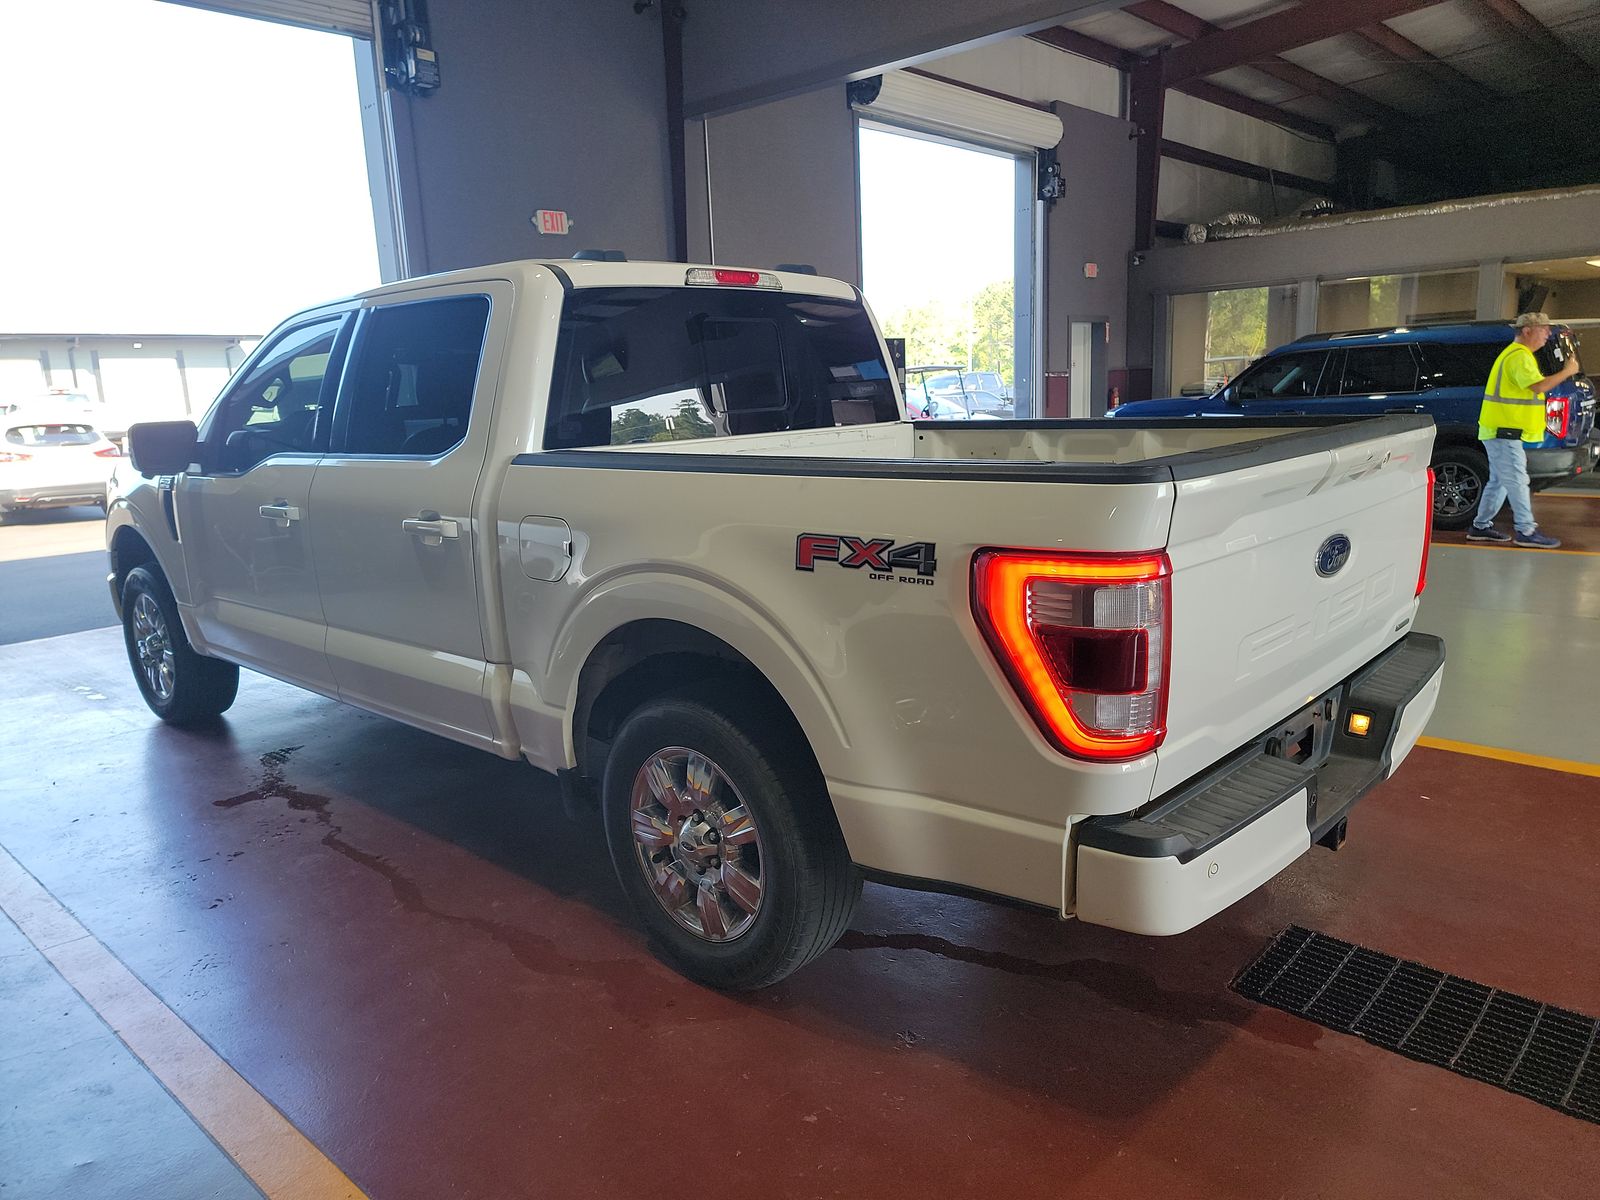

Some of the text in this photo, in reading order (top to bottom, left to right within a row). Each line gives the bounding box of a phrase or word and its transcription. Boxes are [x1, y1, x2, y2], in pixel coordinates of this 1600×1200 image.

[543, 211, 564, 232] EXIT
[796, 532, 937, 577] FX4
[1323, 541, 1348, 570] Ford
[869, 573, 935, 586] OFF ROAD
